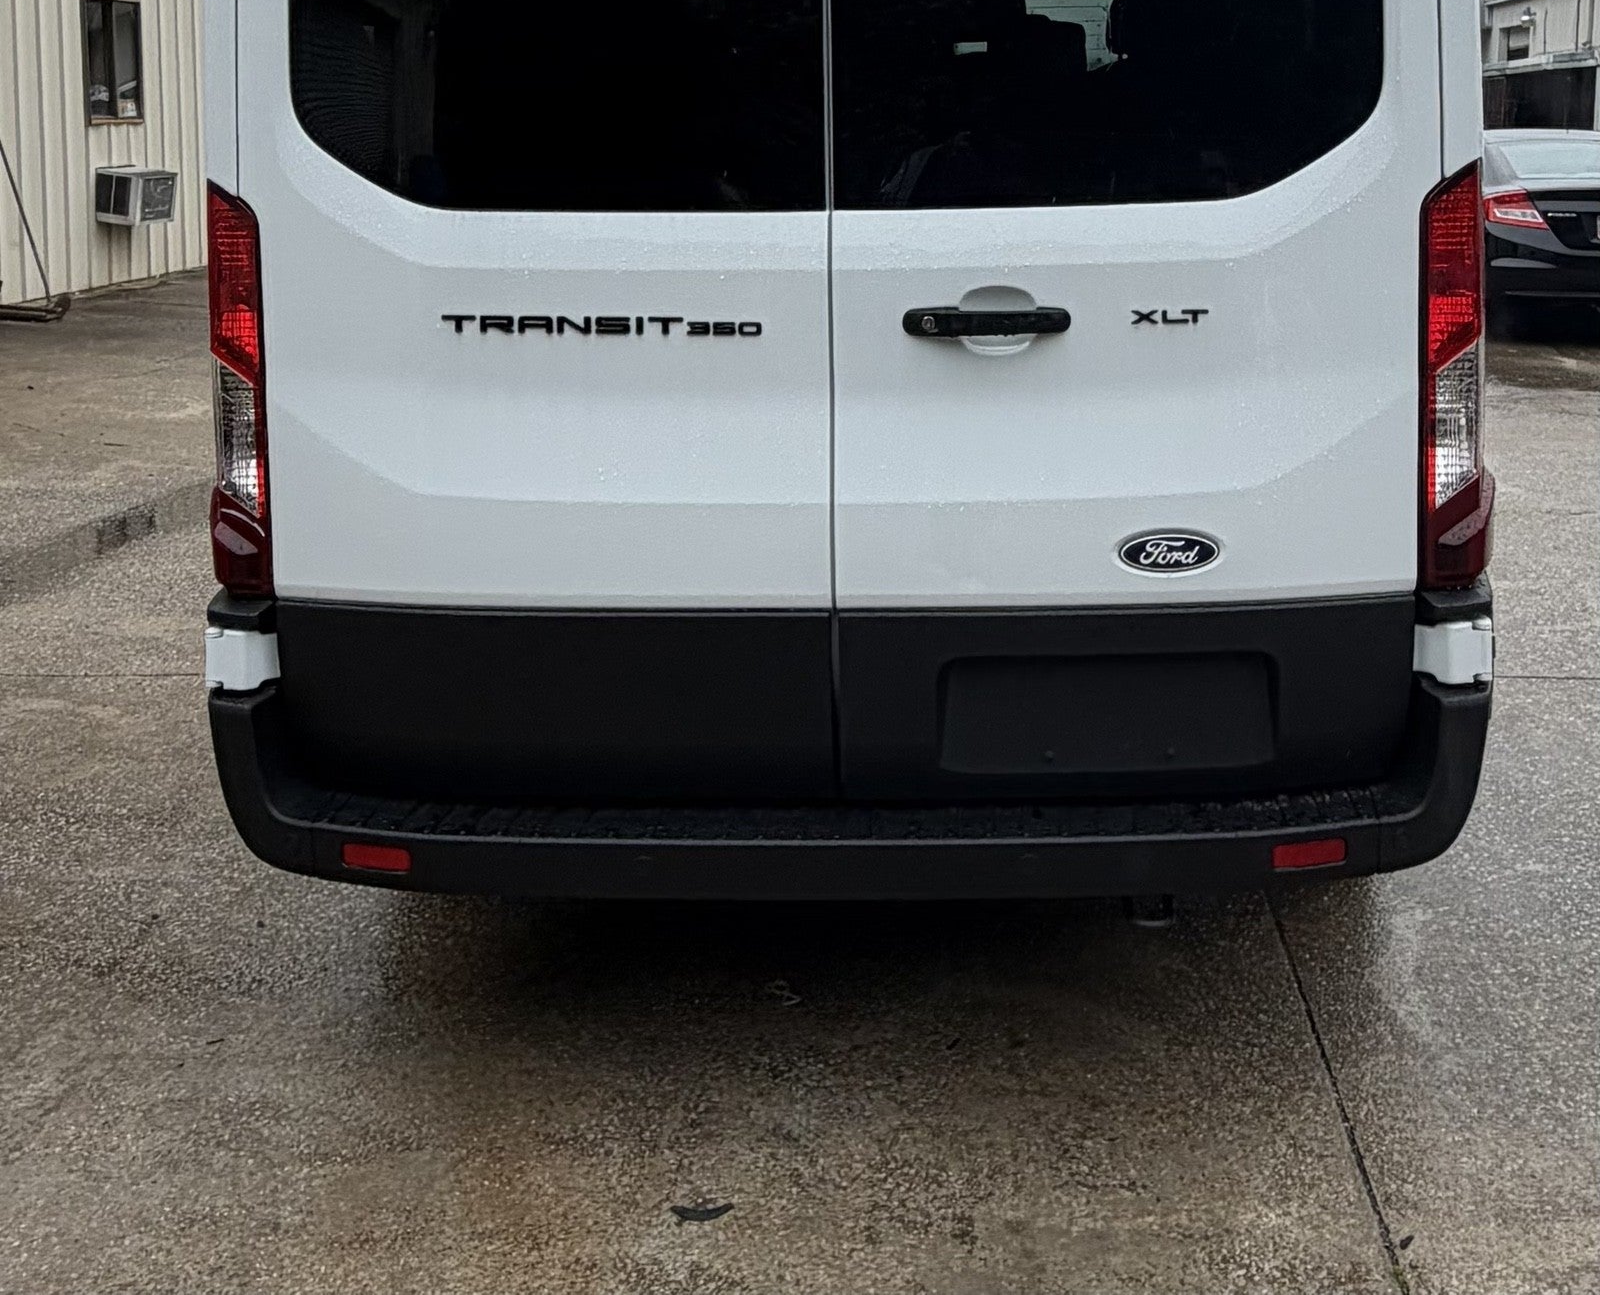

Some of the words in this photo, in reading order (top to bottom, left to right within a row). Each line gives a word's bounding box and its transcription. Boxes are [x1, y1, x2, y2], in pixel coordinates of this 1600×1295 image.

[441, 314, 684, 335] TRANSIT
[686, 321, 763, 336] 350
[1131, 309, 1209, 325] XLT
[1139, 540, 1200, 565] Ford
